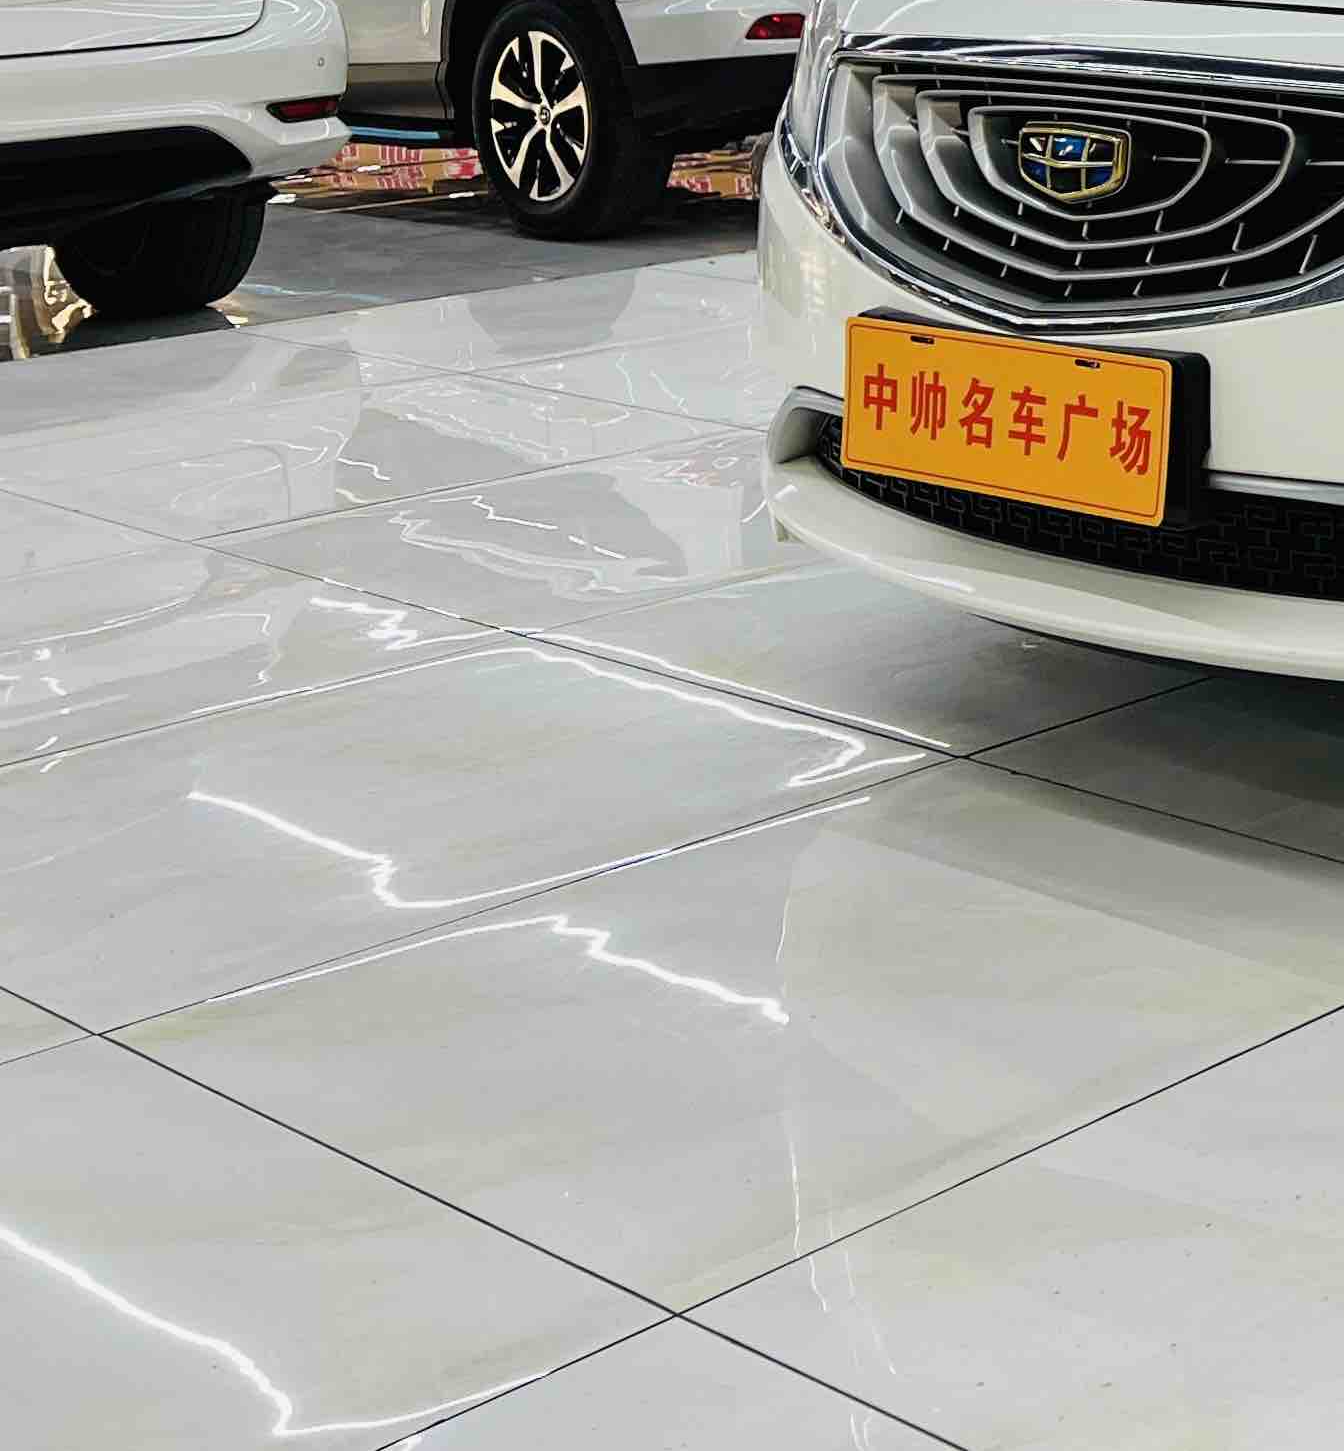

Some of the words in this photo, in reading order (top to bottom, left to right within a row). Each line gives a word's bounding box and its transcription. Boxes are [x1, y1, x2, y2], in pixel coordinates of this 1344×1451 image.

[863, 363, 1152, 475] 中帅名车广场
